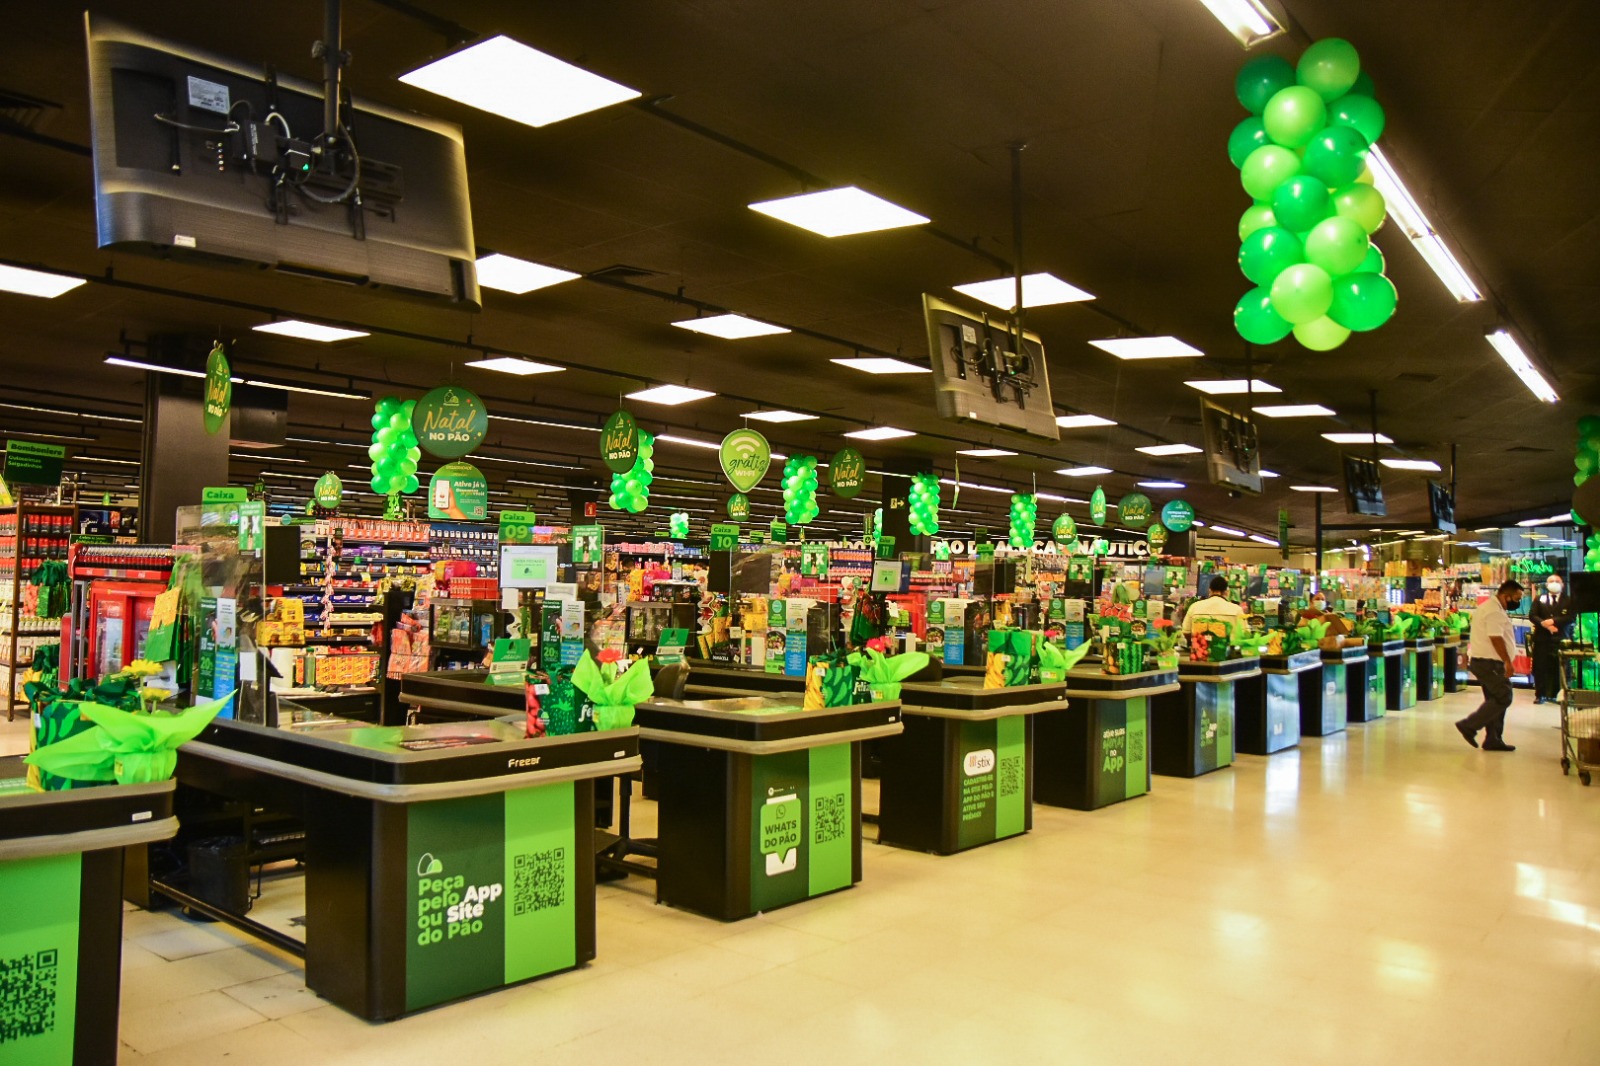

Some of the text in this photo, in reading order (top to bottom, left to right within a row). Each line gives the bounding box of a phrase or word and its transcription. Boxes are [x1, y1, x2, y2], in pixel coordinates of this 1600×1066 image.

[423, 407, 476, 432] Natal
[429, 432, 470, 442] NO PÃO
[606, 428, 632, 453] Natal
[618, 450, 630, 458] PÃO
[834, 463, 860, 482] Natal
[319, 484, 338, 497] Natal
[1123, 504, 1147, 515] Natal
[505, 525, 528, 538] 09
[717, 536, 732, 548] 10
[977, 756, 990, 768] stix
[1103, 756, 1123, 774] App
[765, 820, 797, 835] WHATS
[764, 832, 796, 848] DO PÃO
[418, 875, 464, 896] Peça
[418, 883, 502, 916] pelo App
[418, 901, 484, 929] ou Site
[418, 919, 483, 945] do Pão
